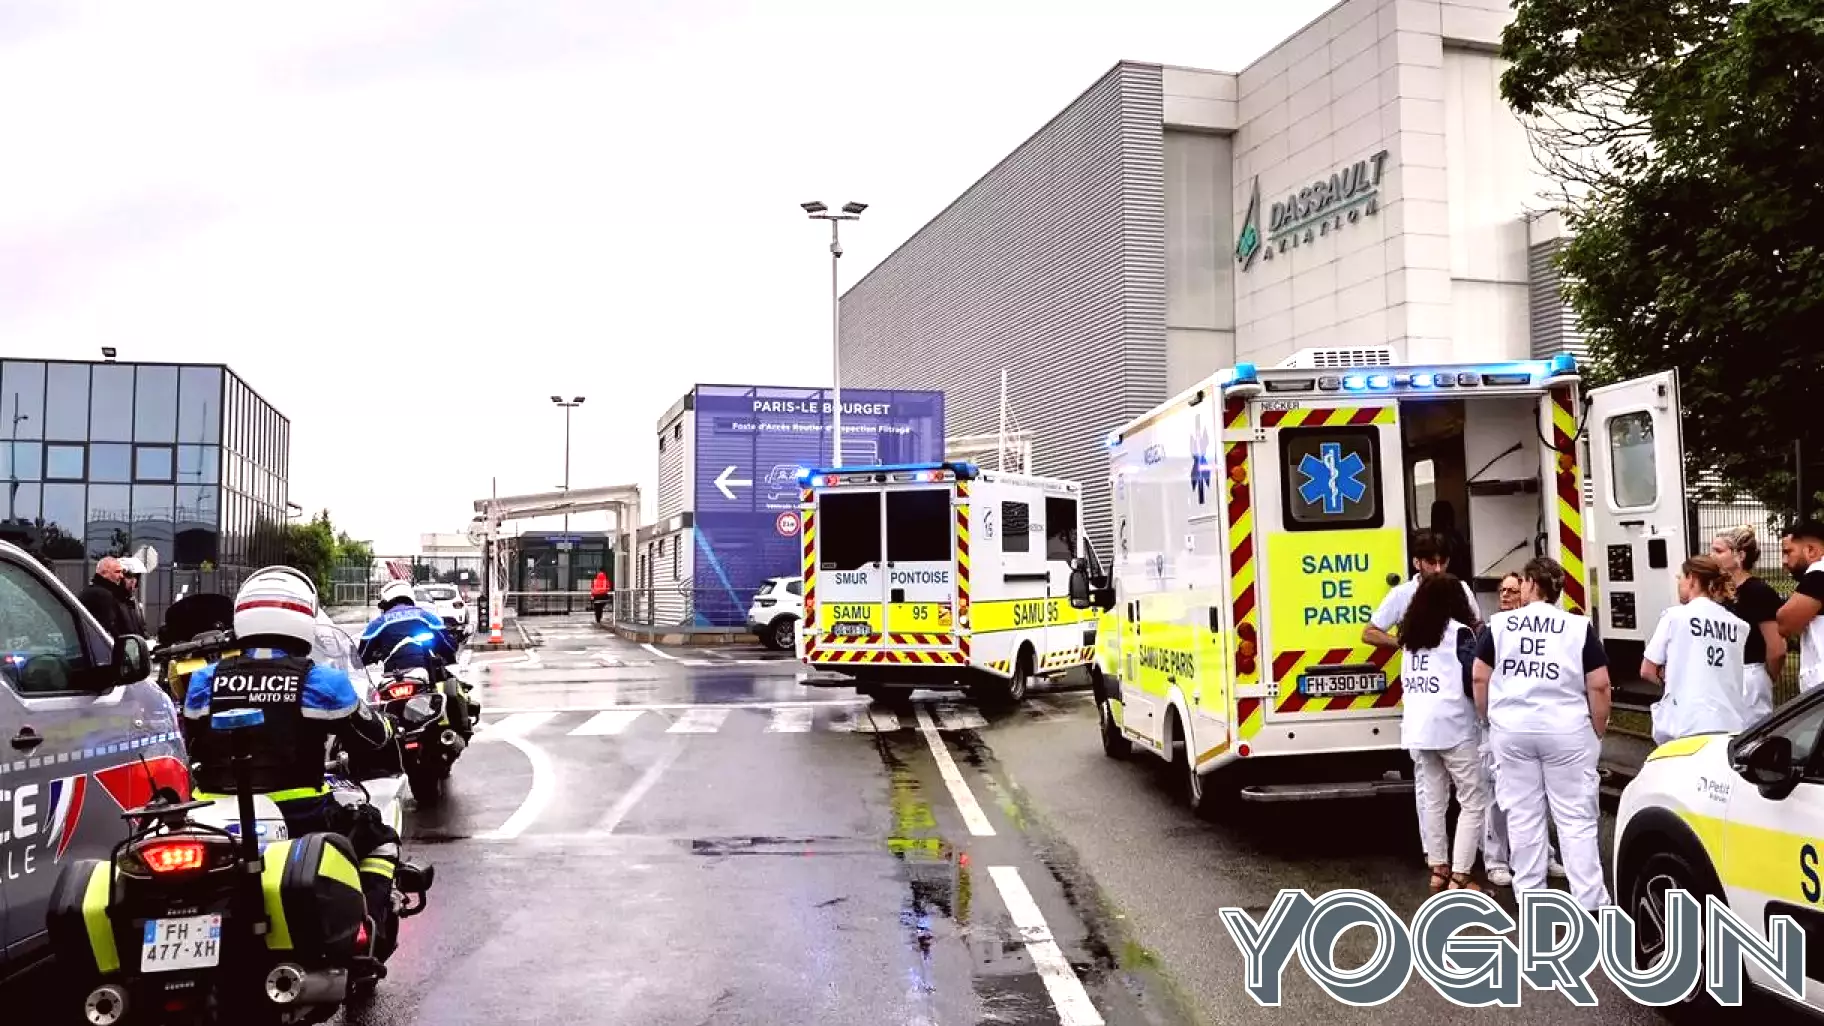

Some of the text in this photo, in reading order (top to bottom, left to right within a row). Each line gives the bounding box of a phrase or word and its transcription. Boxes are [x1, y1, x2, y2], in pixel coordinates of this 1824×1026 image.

[1269, 149, 1388, 232] DASSAULT
[1263, 199, 1379, 261] AVIATION
[753, 401, 818, 414] PARIS-LE
[1261, 400, 1300, 410] NECKER
[1301, 553, 1369, 574] SAMU
[835, 571, 949, 585] SMUR PONTOISE
[1322, 580, 1353, 599] DE
[833, 605, 871, 619] SAMU
[912, 605, 928, 620] 95
[1014, 601, 1058, 626] SAMU 95
[1304, 605, 1372, 625] PARIS
[1506, 615, 1565, 634] SAMU
[1690, 617, 1738, 643] SAMU
[1520, 636, 1546, 656] DE
[1139, 644, 1159, 669] SAMU
[1159, 648, 1170, 673] DE
[1171, 650, 1195, 679] PARIS
[1411, 654, 1429, 672] DE
[1707, 645, 1725, 668] 92
[1502, 659, 1560, 680] PARIS
[213, 675, 299, 692] POLICE
[248, 692, 297, 703] MOTO 93
[1800, 843, 1824, 905] S
[147, 940, 216, 961] 477-XH
